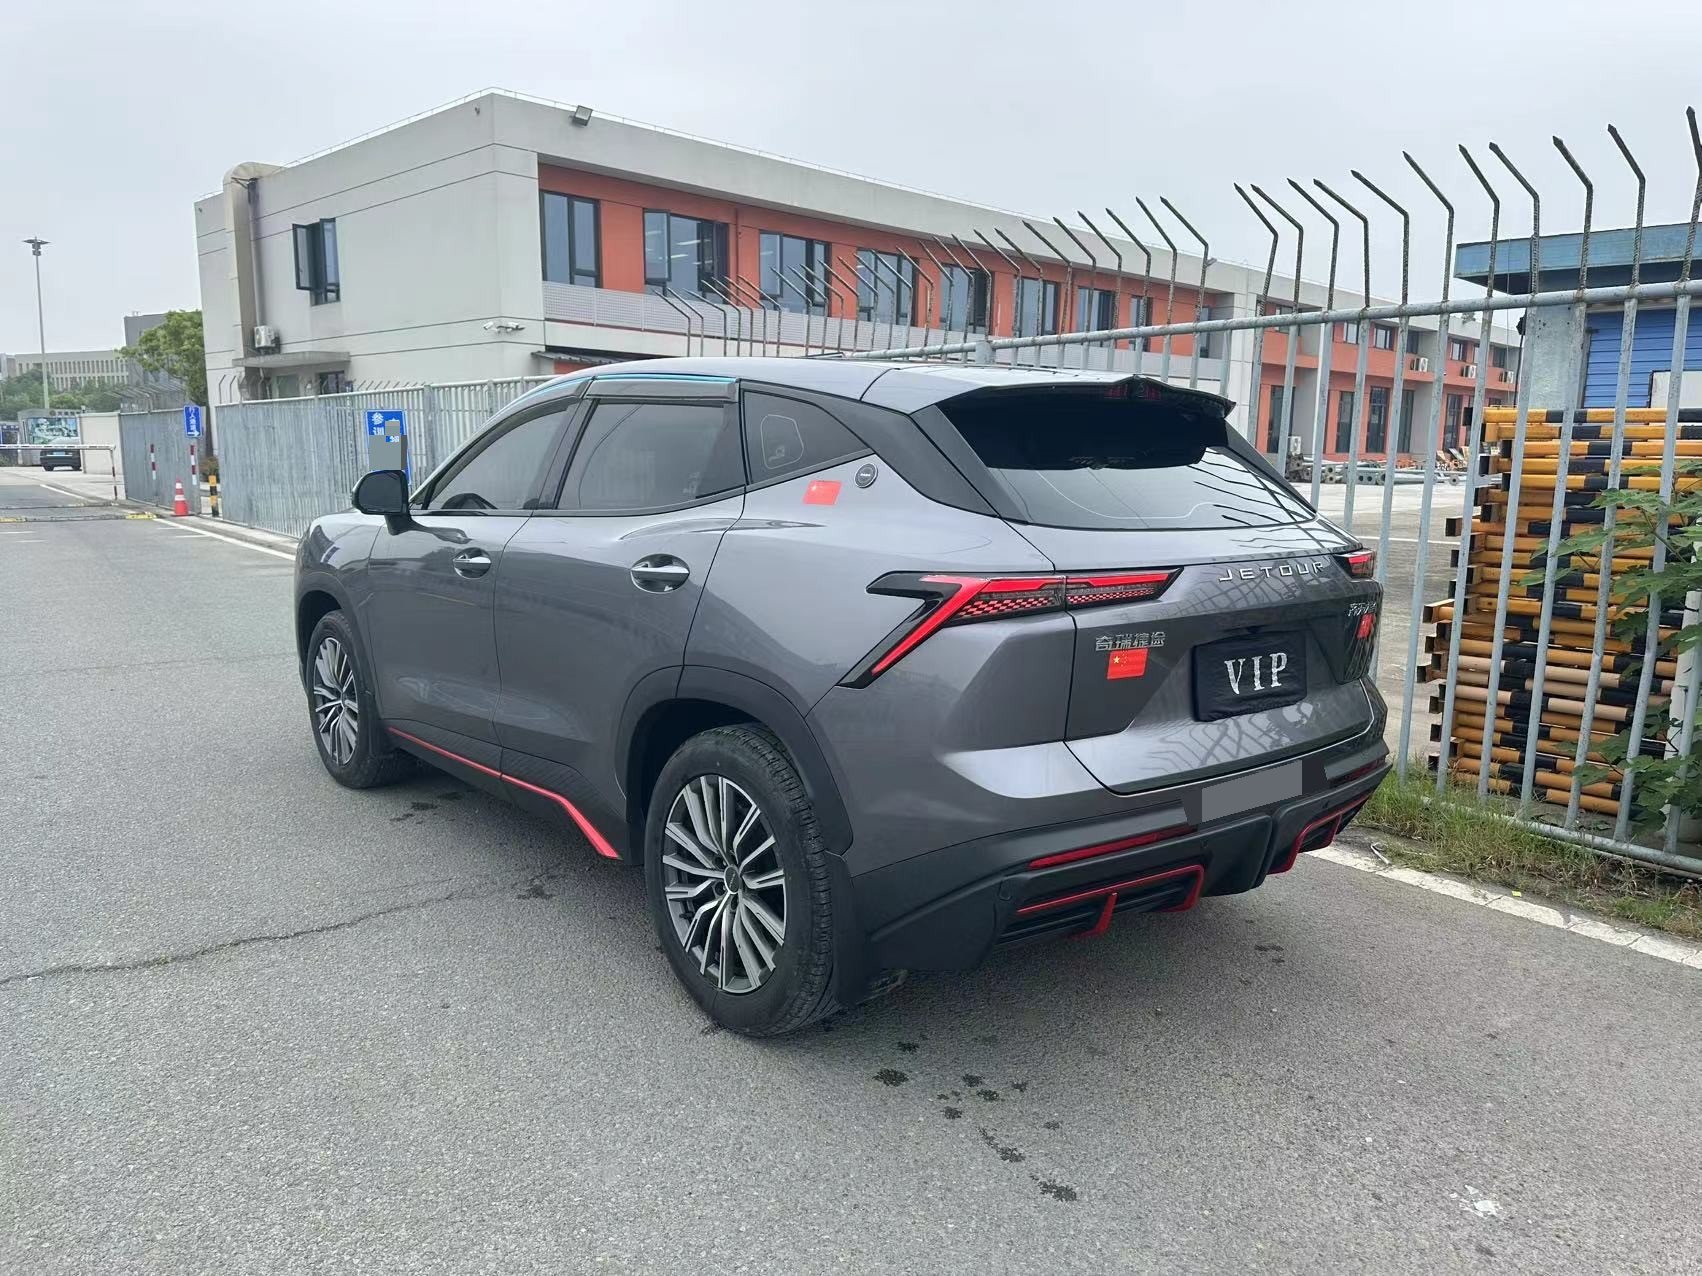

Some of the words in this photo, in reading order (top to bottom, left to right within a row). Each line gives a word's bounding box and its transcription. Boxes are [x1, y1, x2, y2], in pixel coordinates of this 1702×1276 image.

[1219, 561, 1323, 582] JETOUR
[1095, 631, 1166, 651] 奇瑞捷途
[1224, 652, 1288, 695] VIP
